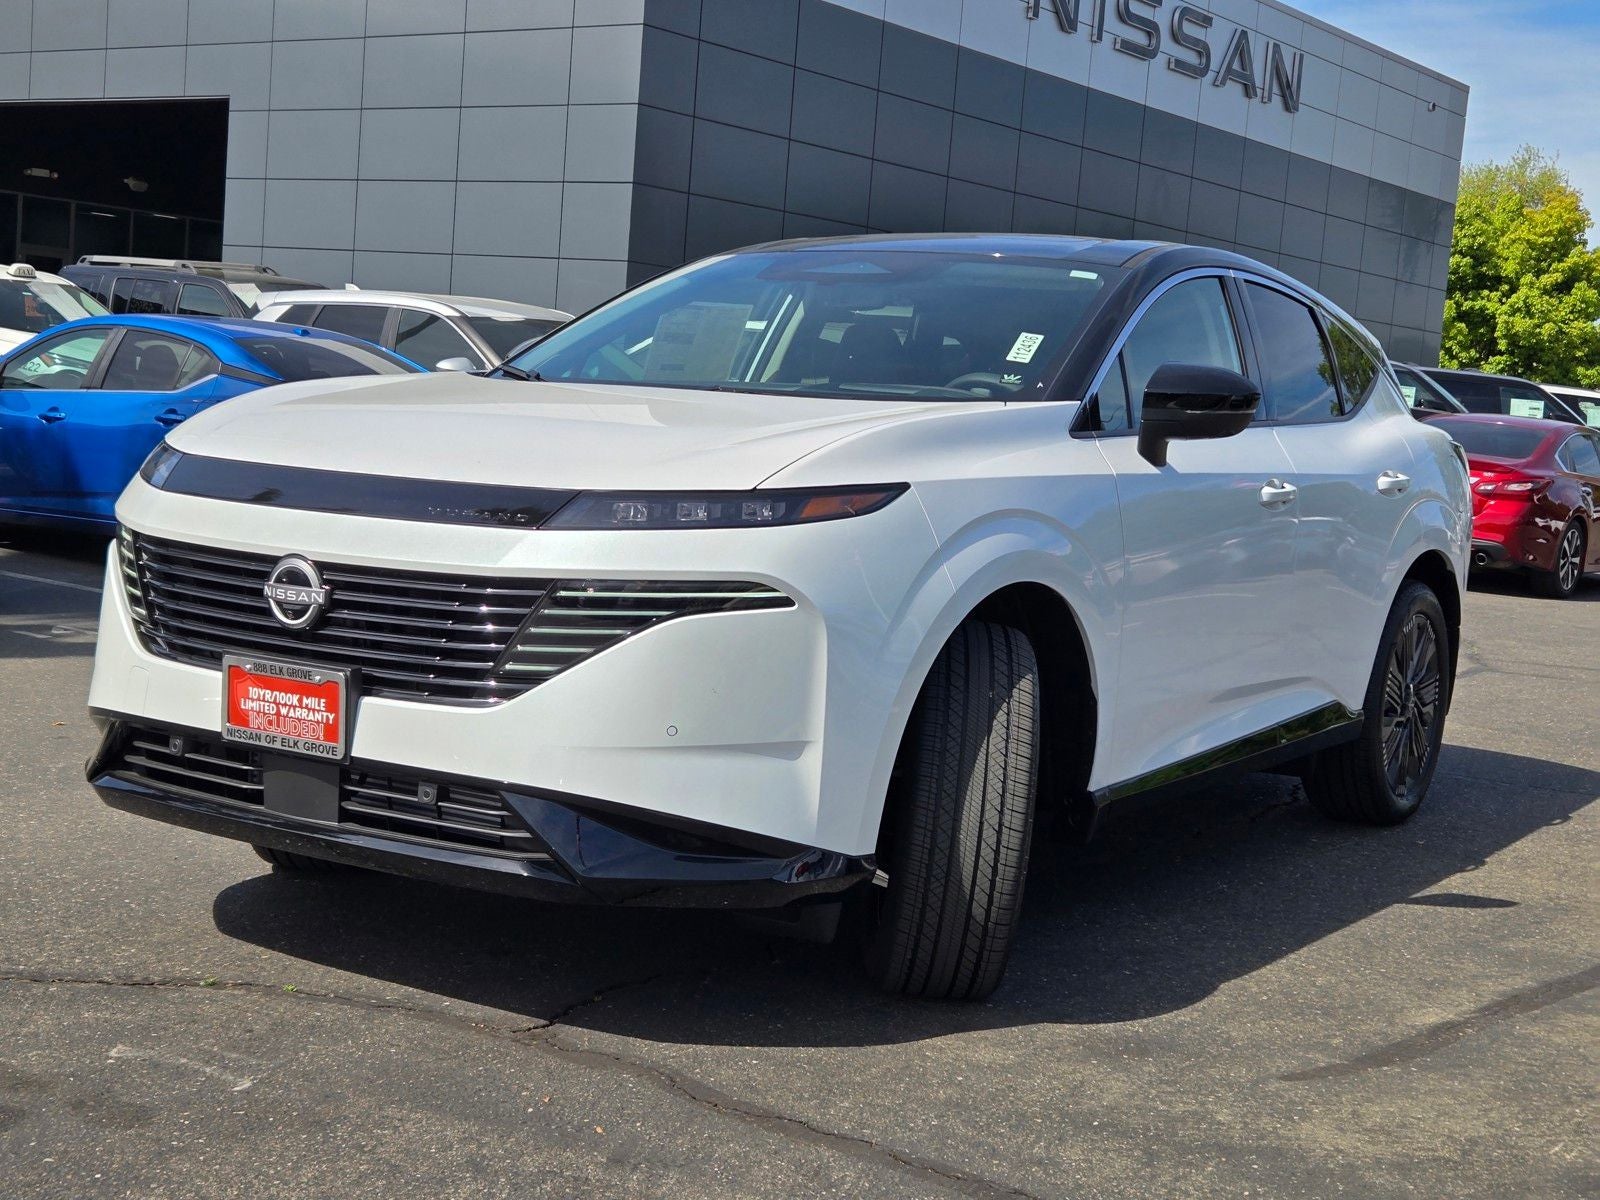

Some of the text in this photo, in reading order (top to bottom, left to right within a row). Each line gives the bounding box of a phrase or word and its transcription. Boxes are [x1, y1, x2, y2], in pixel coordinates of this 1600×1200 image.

[17, 268, 34, 276] TAXI
[264, 585, 323, 603] NISSAN
[253, 662, 313, 680] 888 ELK GROVE
[240, 698, 335, 724] LIMITED WARRANTY
[248, 686, 326, 711] 10YR/100K MILE
[248, 711, 324, 740] INCLUDED!
[226, 727, 338, 756] NISSAN OF ELK GROVE
